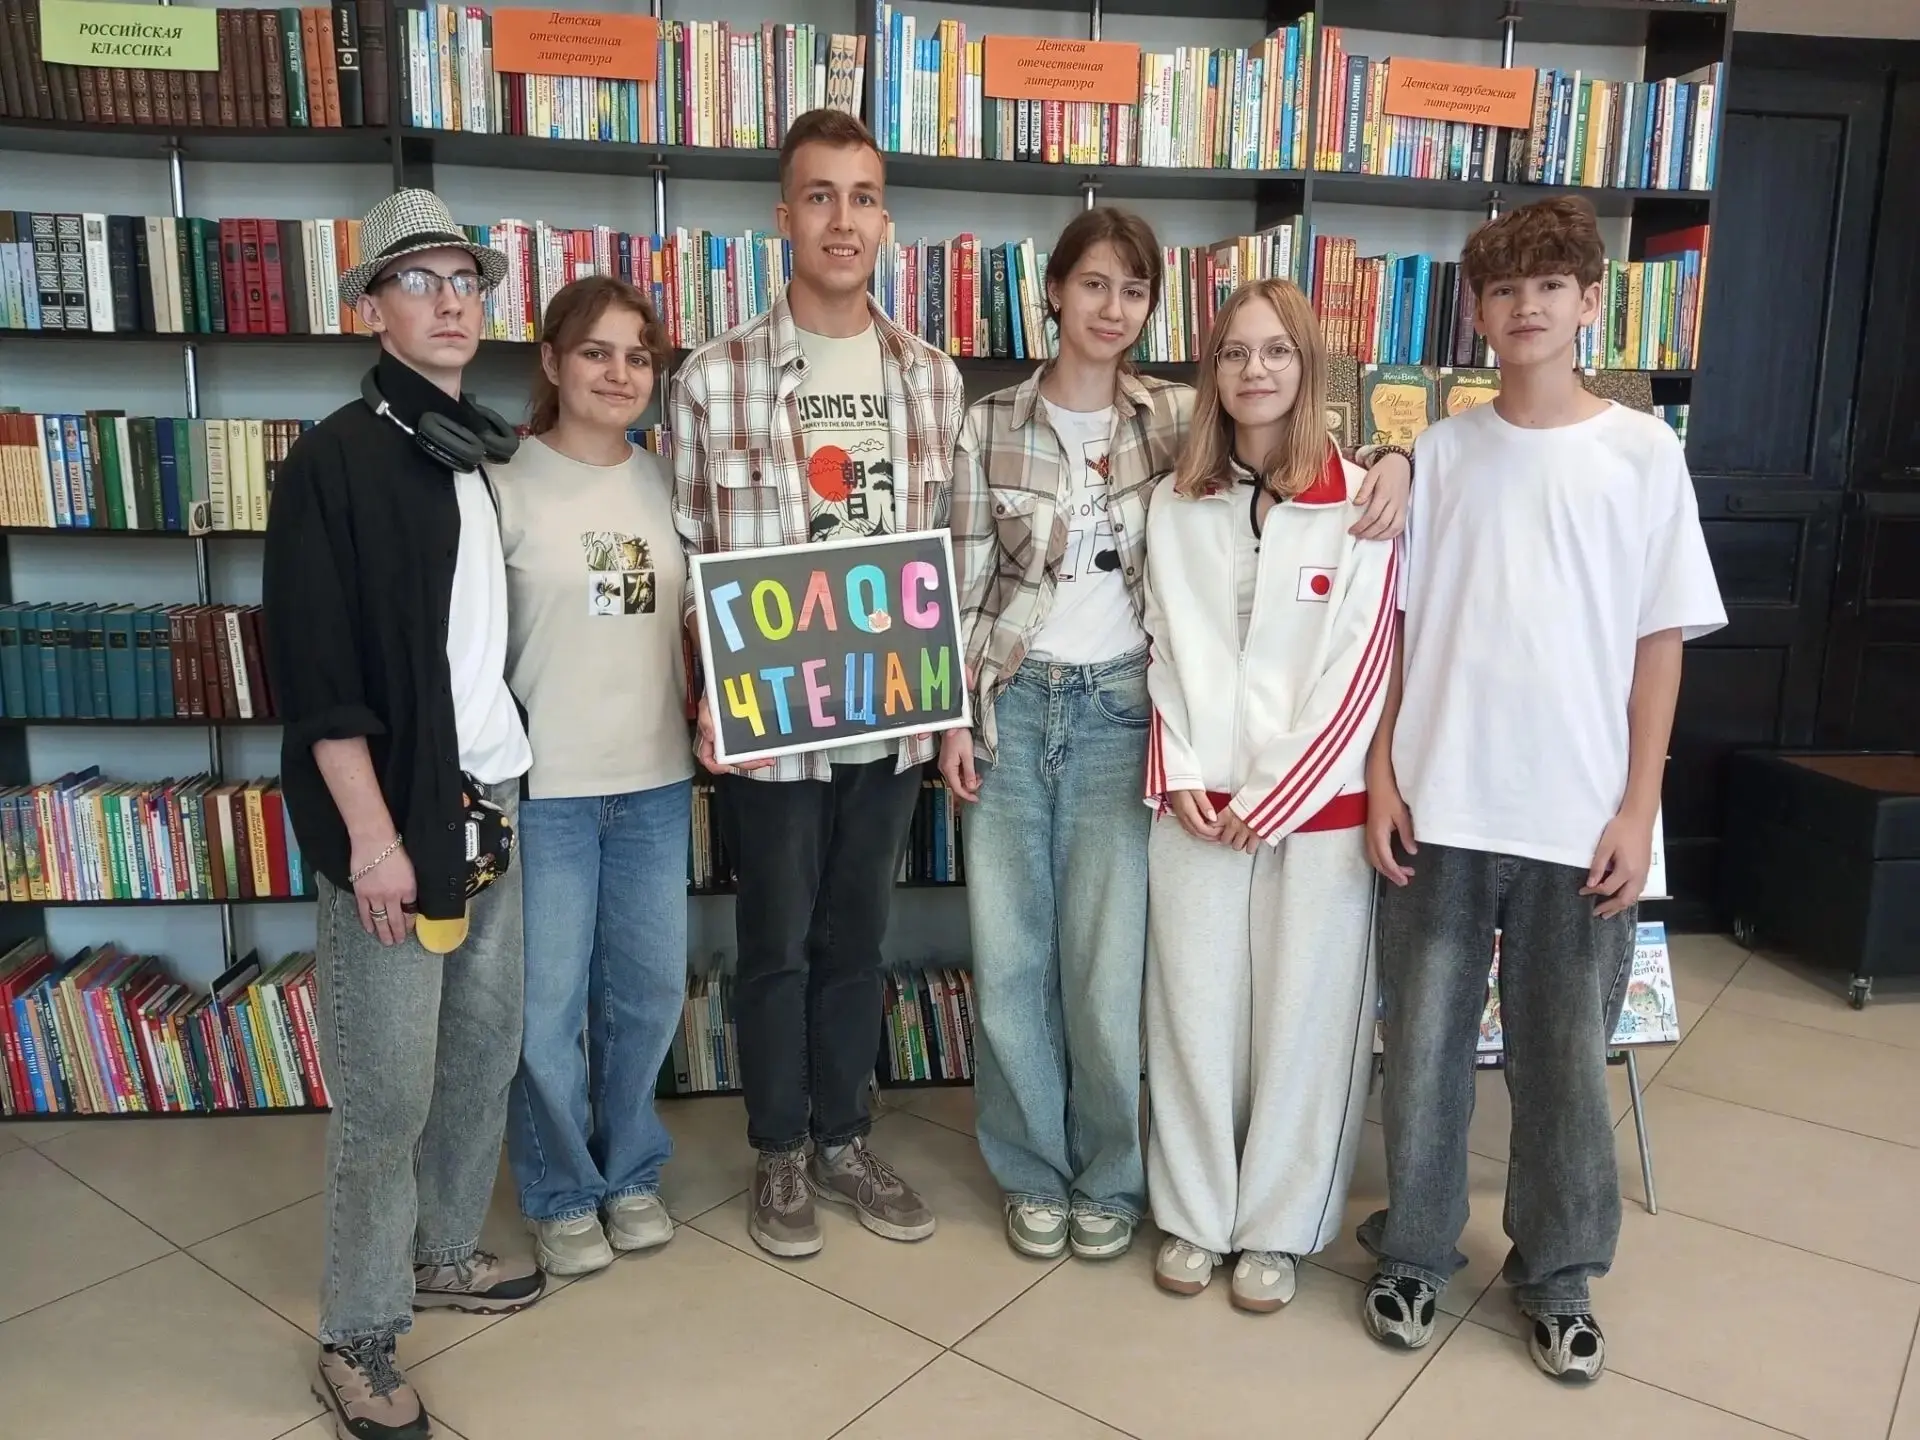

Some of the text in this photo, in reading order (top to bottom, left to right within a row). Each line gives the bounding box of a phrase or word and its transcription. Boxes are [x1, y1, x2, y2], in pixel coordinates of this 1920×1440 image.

[548, 12, 602, 27] Детская
[79, 22, 183, 39] РОССИЙСКАЯ
[529, 32, 622, 47] отечественная
[1036, 40, 1086, 53] Детская
[90, 42, 172, 57] КЛАССИКА
[537, 51, 612, 66] литература
[1017, 57, 1104, 72] отечественная
[1024, 75, 1095, 90] литература
[1401, 76, 1516, 99] Детская зарубежная
[1423, 98, 1490, 114] литература
[1348, 74, 1361, 154] ХРОНИКИ НАРНИИ
[829, 421, 840, 430] THE
[841, 421, 857, 430] SOUL
[71, 465, 83, 511] ТУРГЕНЕВ
[710, 561, 940, 653] ГОЛОС
[228, 617, 237, 641] ЧЕХОВ
[723, 646, 949, 737] ЧТЕЦАМ
